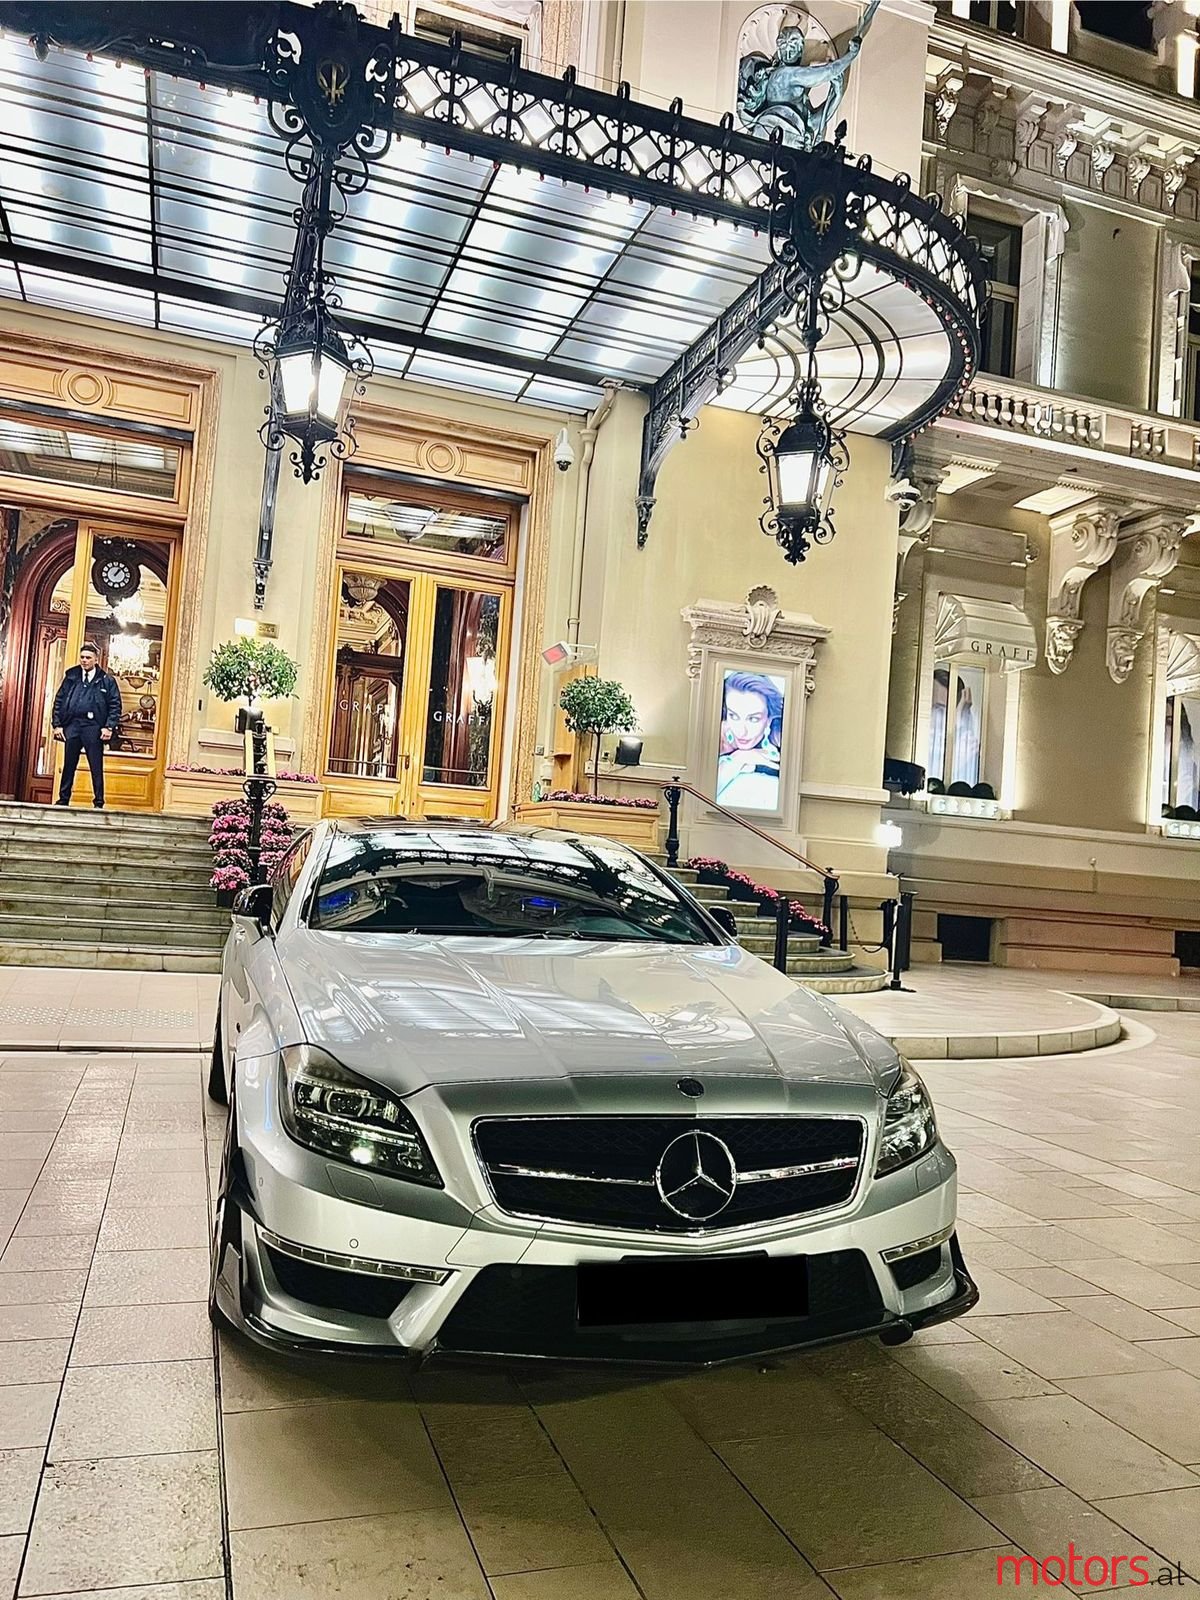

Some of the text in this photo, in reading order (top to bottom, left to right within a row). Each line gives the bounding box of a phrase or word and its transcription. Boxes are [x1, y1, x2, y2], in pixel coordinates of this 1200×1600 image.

[970, 640, 1033, 661] GRAFF
[339, 699, 394, 717] GRAF
[433, 710, 486, 726] GRAFF
[936, 798, 999, 817] GRAFF
